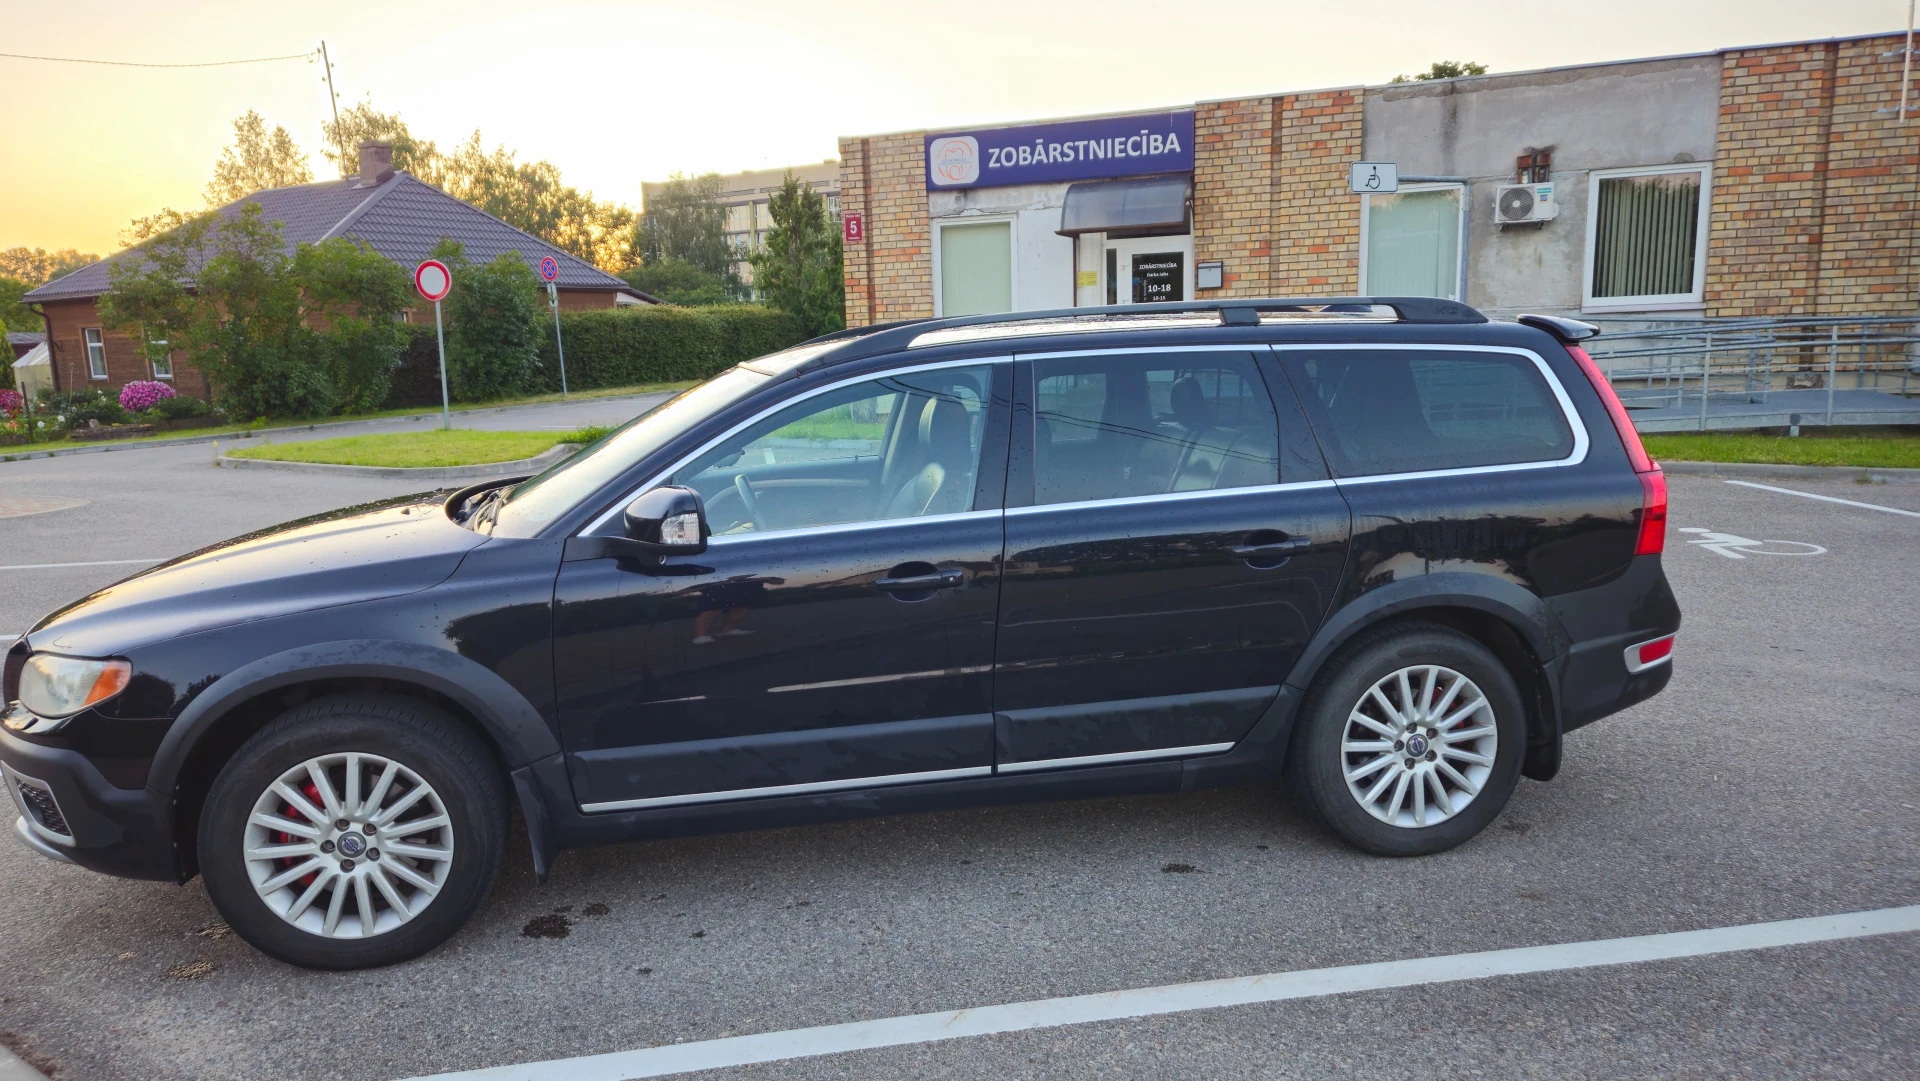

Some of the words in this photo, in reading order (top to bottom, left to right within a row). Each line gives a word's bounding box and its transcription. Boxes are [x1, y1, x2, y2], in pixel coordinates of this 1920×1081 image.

[988, 130, 1181, 168] ZOBĀRSTNIECĪBA
[850, 221, 858, 234] 5
[1148, 284, 1171, 292] 10-18
